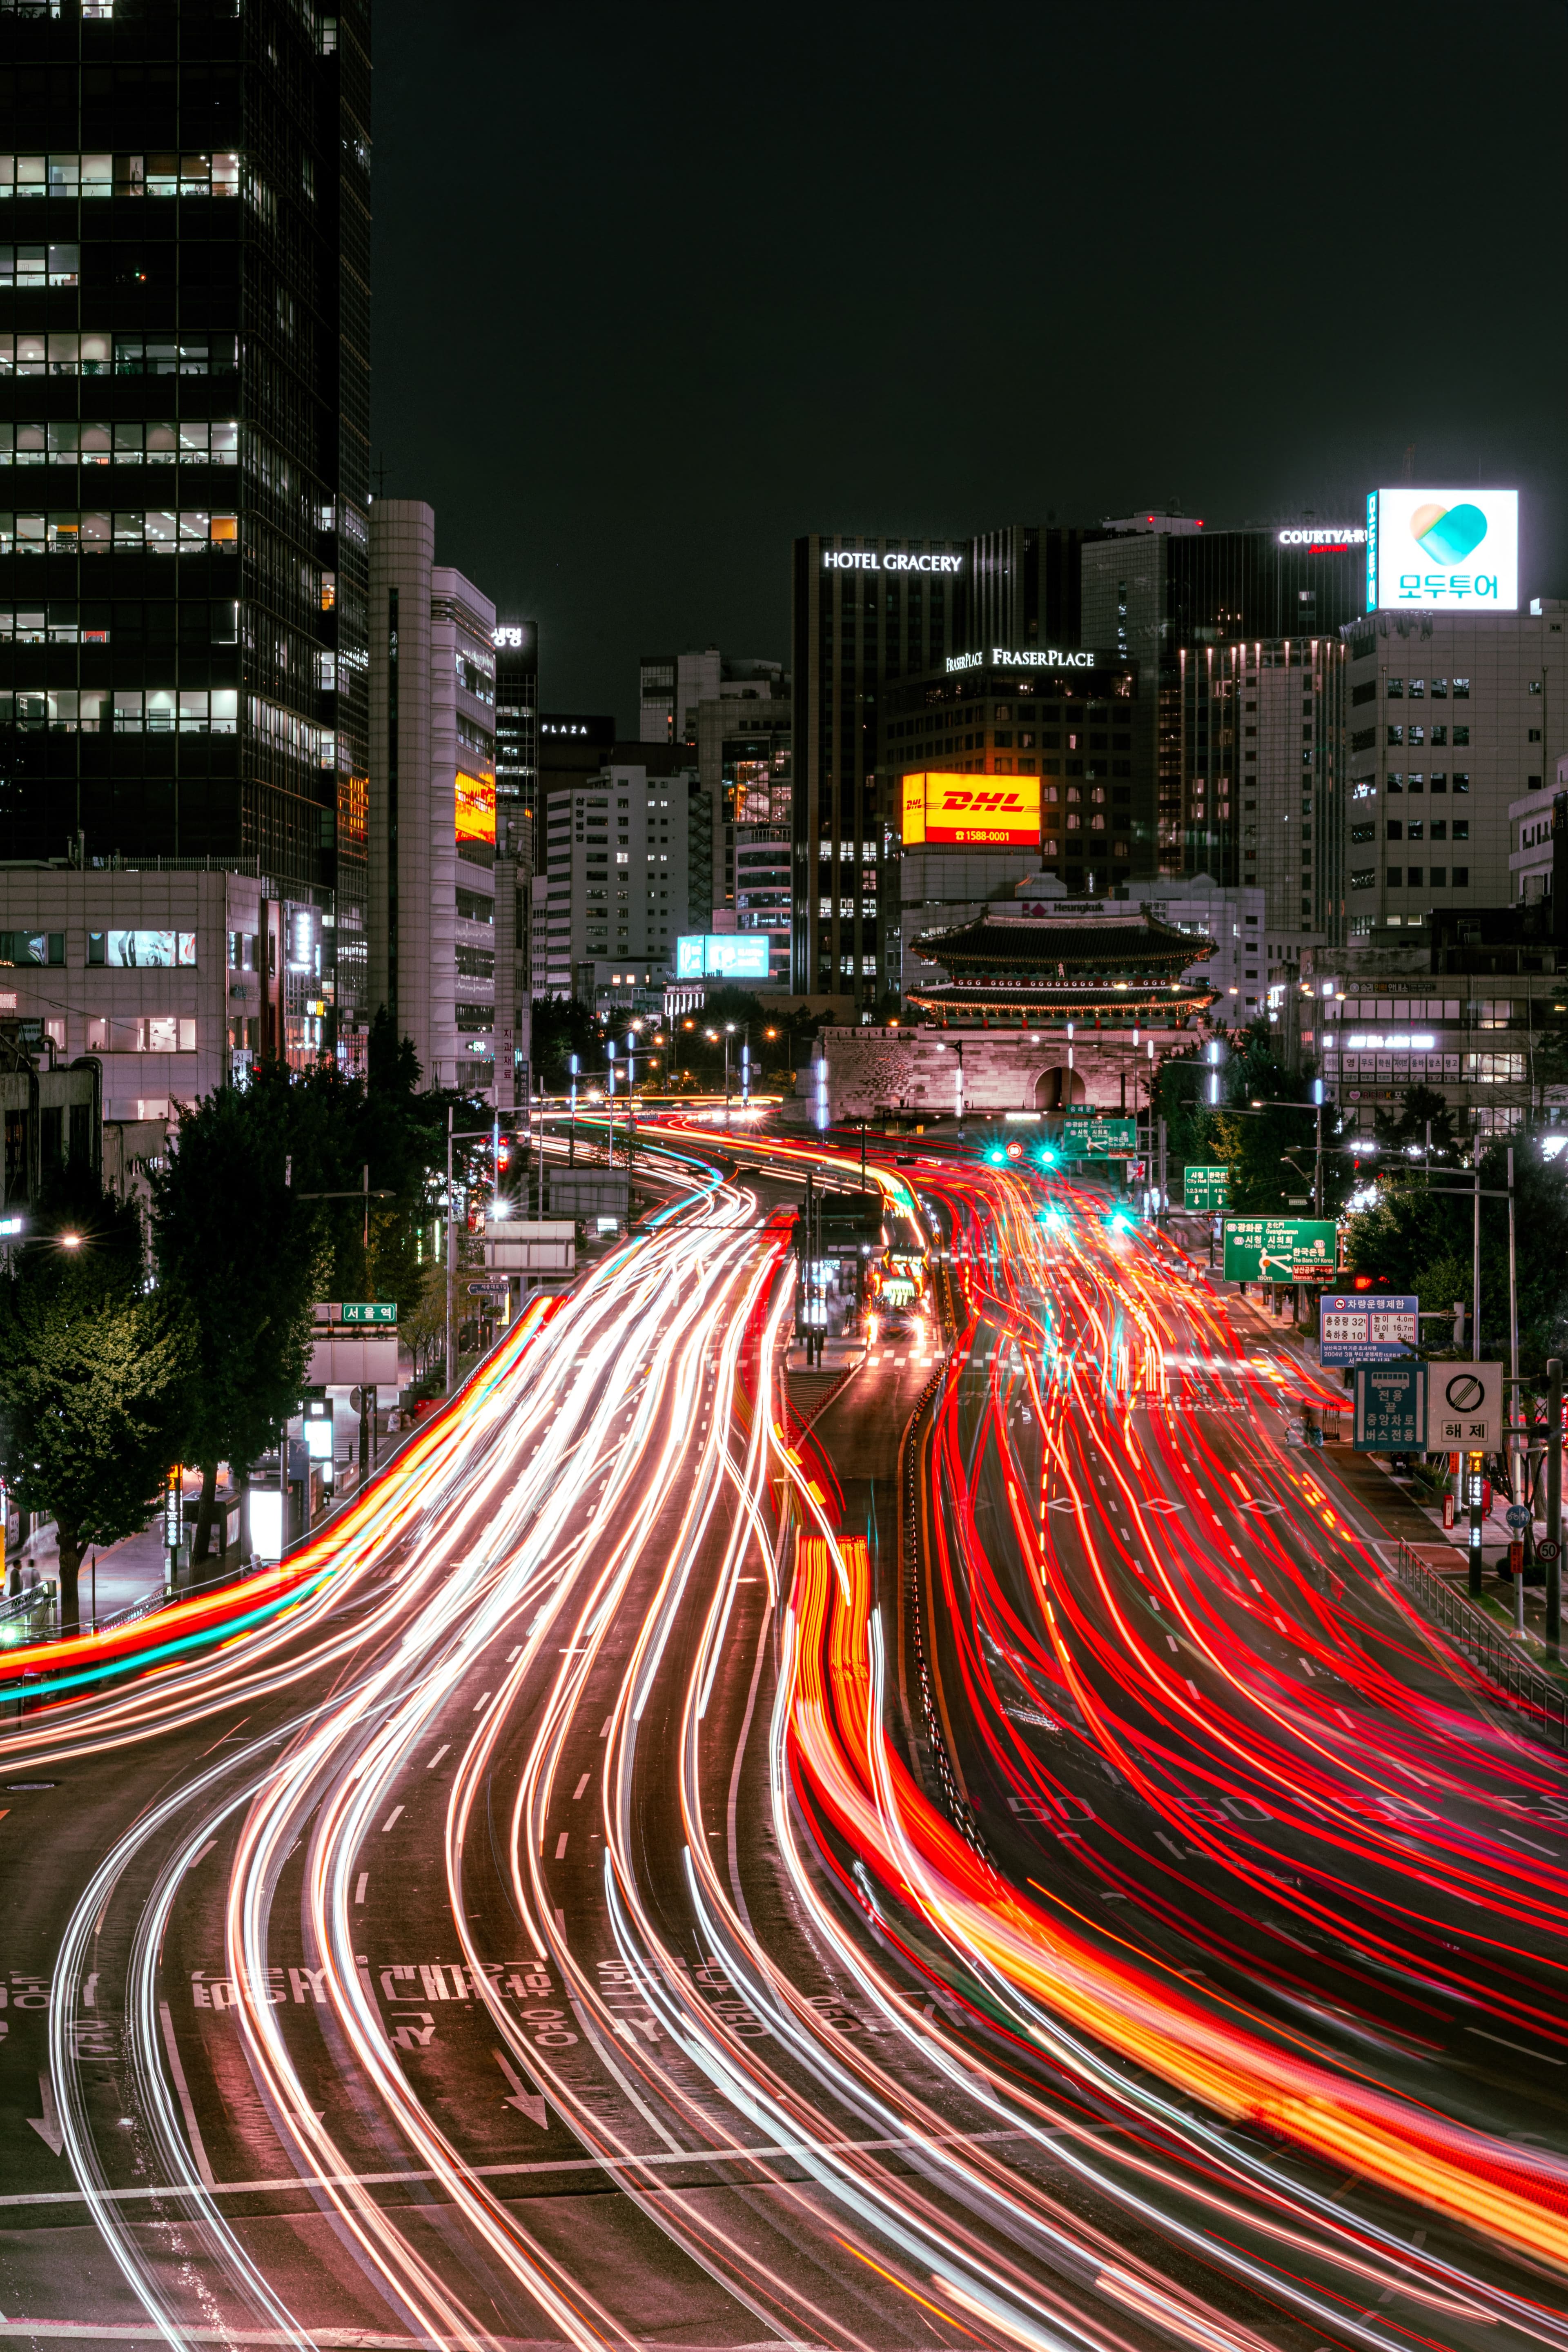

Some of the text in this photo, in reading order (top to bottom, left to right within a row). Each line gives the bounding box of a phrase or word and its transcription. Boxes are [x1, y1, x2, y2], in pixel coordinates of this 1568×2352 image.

[824, 552, 962, 572] HOTEL GRACERY
[1399, 575, 1497, 599] 모두투어
[492, 628, 521, 647] 생명
[542, 725, 587, 734] PLAZA
[906, 799, 922, 810] DHL
[942, 791, 1025, 813] DHL
[966, 831, 1009, 841] 1588-0001
[1054, 902, 1104, 914] Heungkuk
[504, 1029, 512, 1078] 치과재료
[1361, 1059, 1374, 1067] 무도
[1378, 1058, 1390, 1067] 학원
[1412, 1059, 1424, 1067] 룸바
[1446, 1059, 1457, 1067] 탱고
[1238, 1223, 1263, 1232] 광화문
[1245, 1236, 1293, 1244] 시청 시의회
[1293, 1248, 1325, 1256] 한국은행
[1348, 1300, 1405, 1309] 차량운행제한
[347, 1307, 391, 1319] 서울역
[1374, 1315, 1388, 1323] 높이
[1326, 1316, 1349, 1326] 총중량
[1325, 1330, 1348, 1340] 축하중
[1379, 1390, 1403, 1401] 전용
[1385, 1402, 1396, 1413] 끝
[1367, 1414, 1414, 1426] 중앙차로
[1366, 1429, 1414, 1441] 버스전용
[1446, 1424, 1485, 1439] 해제
[1541, 1544, 1555, 1557] 50
[1007, 1797, 1096, 1822] 50
[1175, 1797, 1274, 1822] 50
[1329, 1796, 1440, 1821] 50
[379, 1961, 555, 2000] 한강대교
[0, 1971, 101, 2009] 서울
[191, 1968, 327, 2010] 서울역
[389, 2009, 579, 2050] 용산
